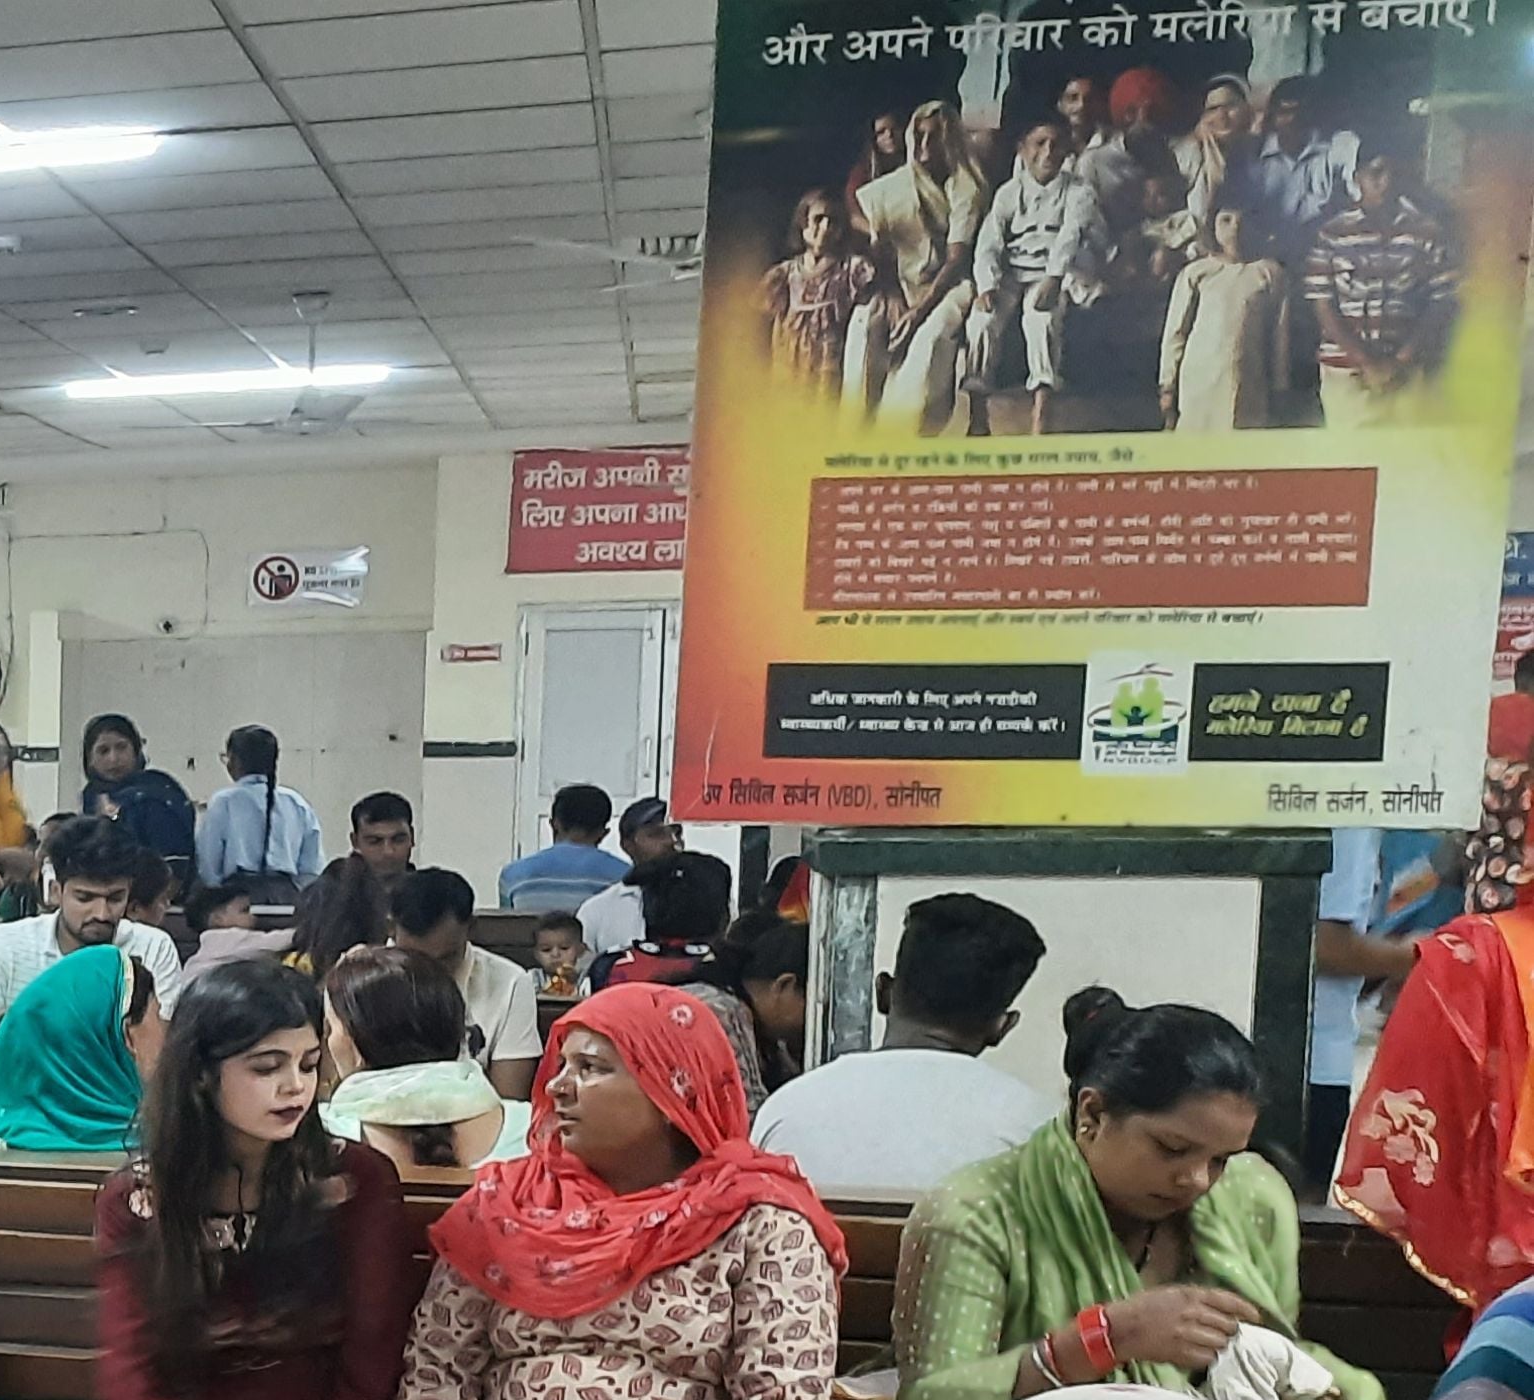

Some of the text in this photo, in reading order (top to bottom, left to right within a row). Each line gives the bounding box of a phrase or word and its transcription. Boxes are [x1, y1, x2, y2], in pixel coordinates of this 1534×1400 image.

[762, 22, 833, 66] और
[842, 15, 933, 61] अपने
[944, 12, 1071, 54] परिवार
[1080, 3, 1138, 48] को
[523, 460, 588, 490] मरीज
[593, 457, 662, 488] अपनी
[521, 498, 566, 528] लिए
[570, 503, 640, 527] अपना
[575, 540, 649, 564] अवश्य
[730, 778, 776, 806] सिविल
[782, 778, 820, 807] सर्जन
[885, 780, 943, 808] सोनीपत
[1267, 783, 1319, 813] सिविल
[1381, 782, 1445, 814] सोनीपत
